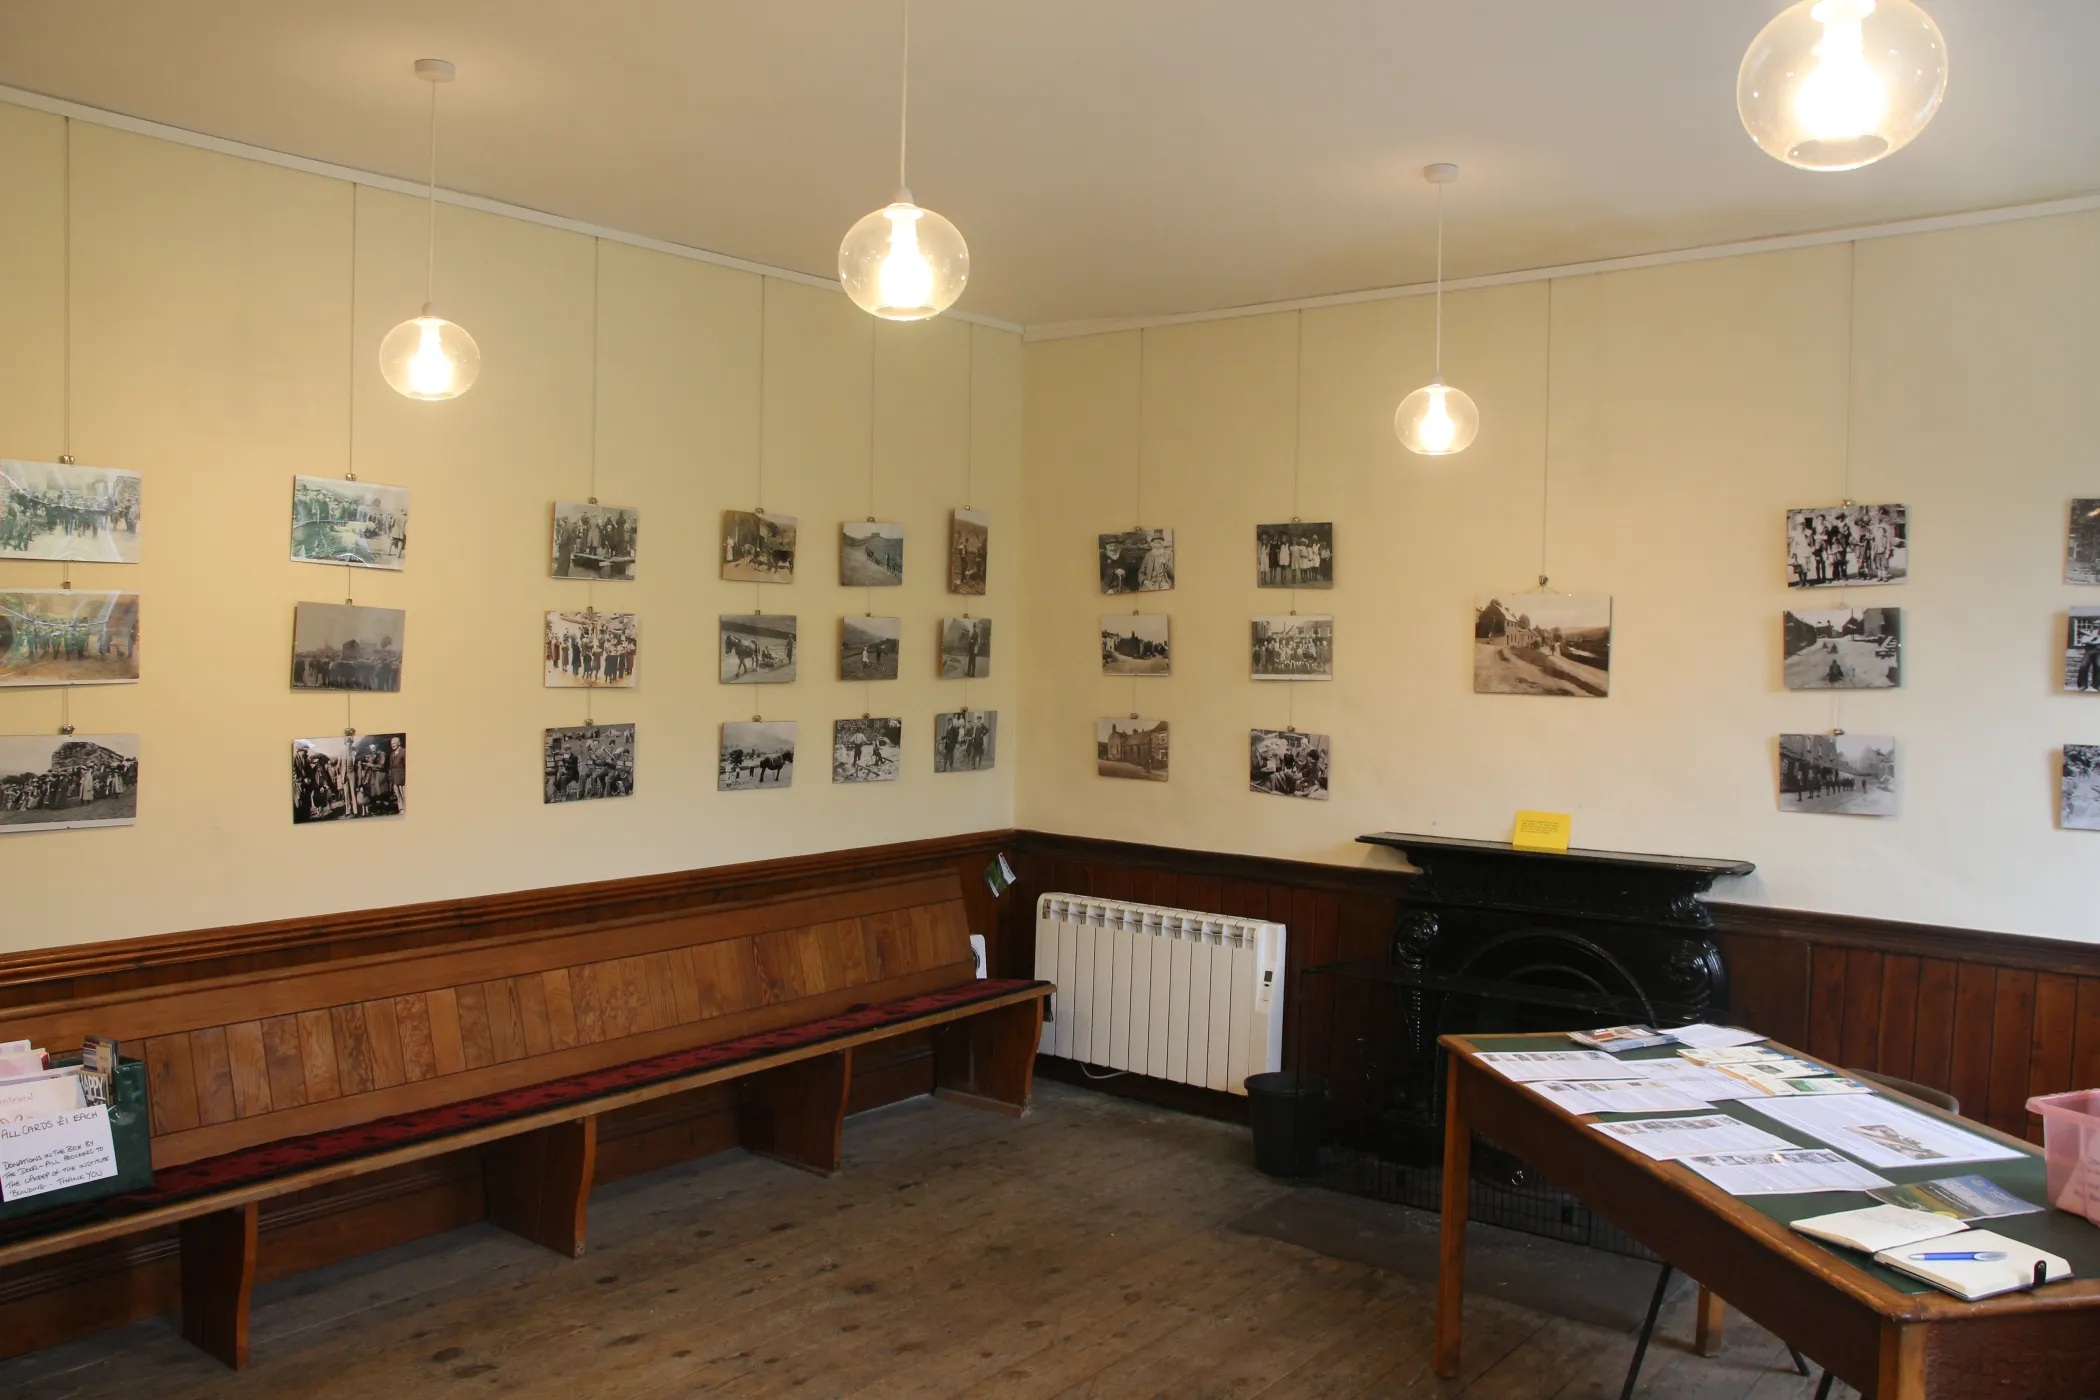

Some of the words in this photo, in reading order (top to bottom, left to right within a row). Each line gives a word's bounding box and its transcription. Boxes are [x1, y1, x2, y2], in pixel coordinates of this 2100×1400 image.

[1, 1129, 20, 1139] ALL
[22, 1121, 53, 1134] CARDS
[56, 1115, 69, 1125] £1
[73, 1111, 98, 1122] EACH
[2, 1155, 43, 1170] DONATIONS
[66, 1144, 82, 1153] BOX
[85, 1140, 94, 1148] BY
[2, 1171, 16, 1179] THE
[56, 1176, 85, 1185] THANK
[85, 1170, 103, 1179] YOU
[5, 1181, 20, 1189] THE
